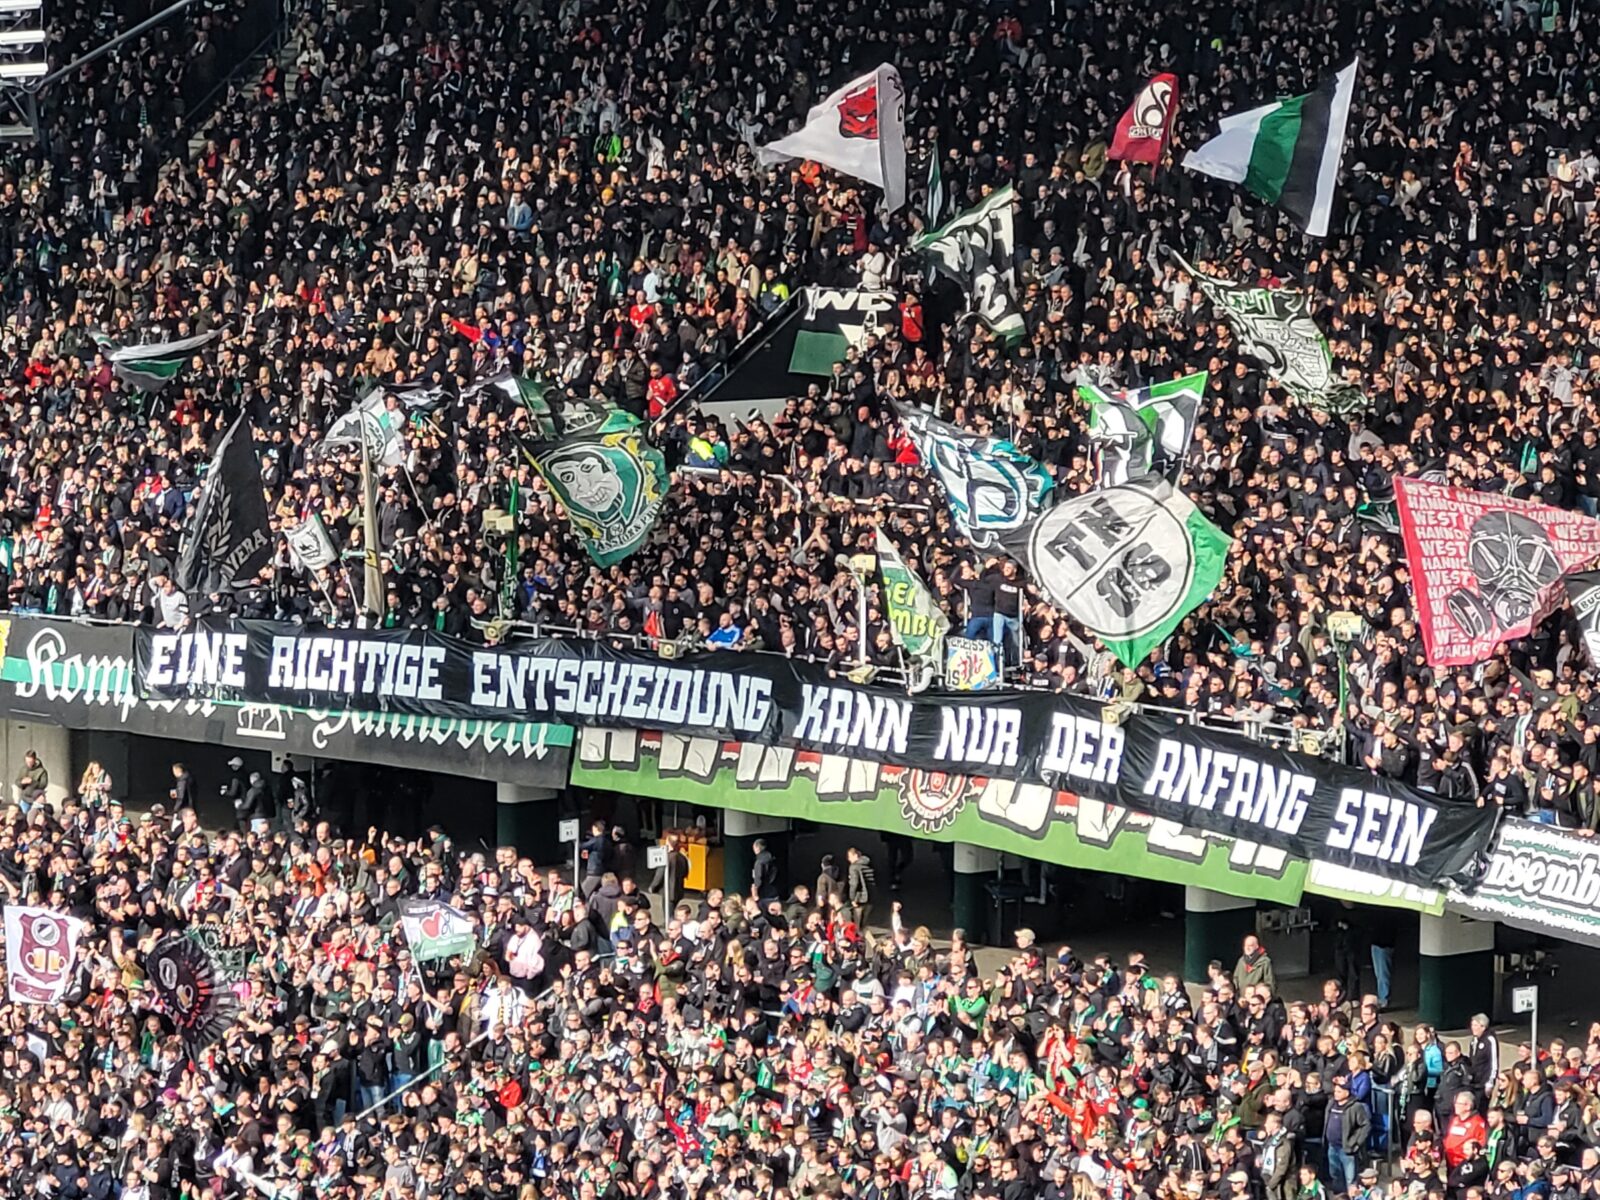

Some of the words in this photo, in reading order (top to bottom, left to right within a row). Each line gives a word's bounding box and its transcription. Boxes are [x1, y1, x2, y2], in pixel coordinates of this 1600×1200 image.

[1402, 481, 1450, 499] WEST
[1407, 496, 1484, 518] HANNOVER
[1411, 511, 1459, 528] WEST
[1420, 540, 1468, 557] WEST
[1425, 570, 1472, 587] WEST
[147, 632, 248, 687] EINE
[268, 635, 446, 700] RICHTIGE
[471, 652, 773, 734] ENTSCHEIDUNG
[795, 684, 914, 753] KANN
[935, 705, 1020, 766] NUR
[1046, 712, 1126, 785] DER
[1143, 739, 1317, 836] ANFANG
[1326, 787, 1438, 867] SEIN
